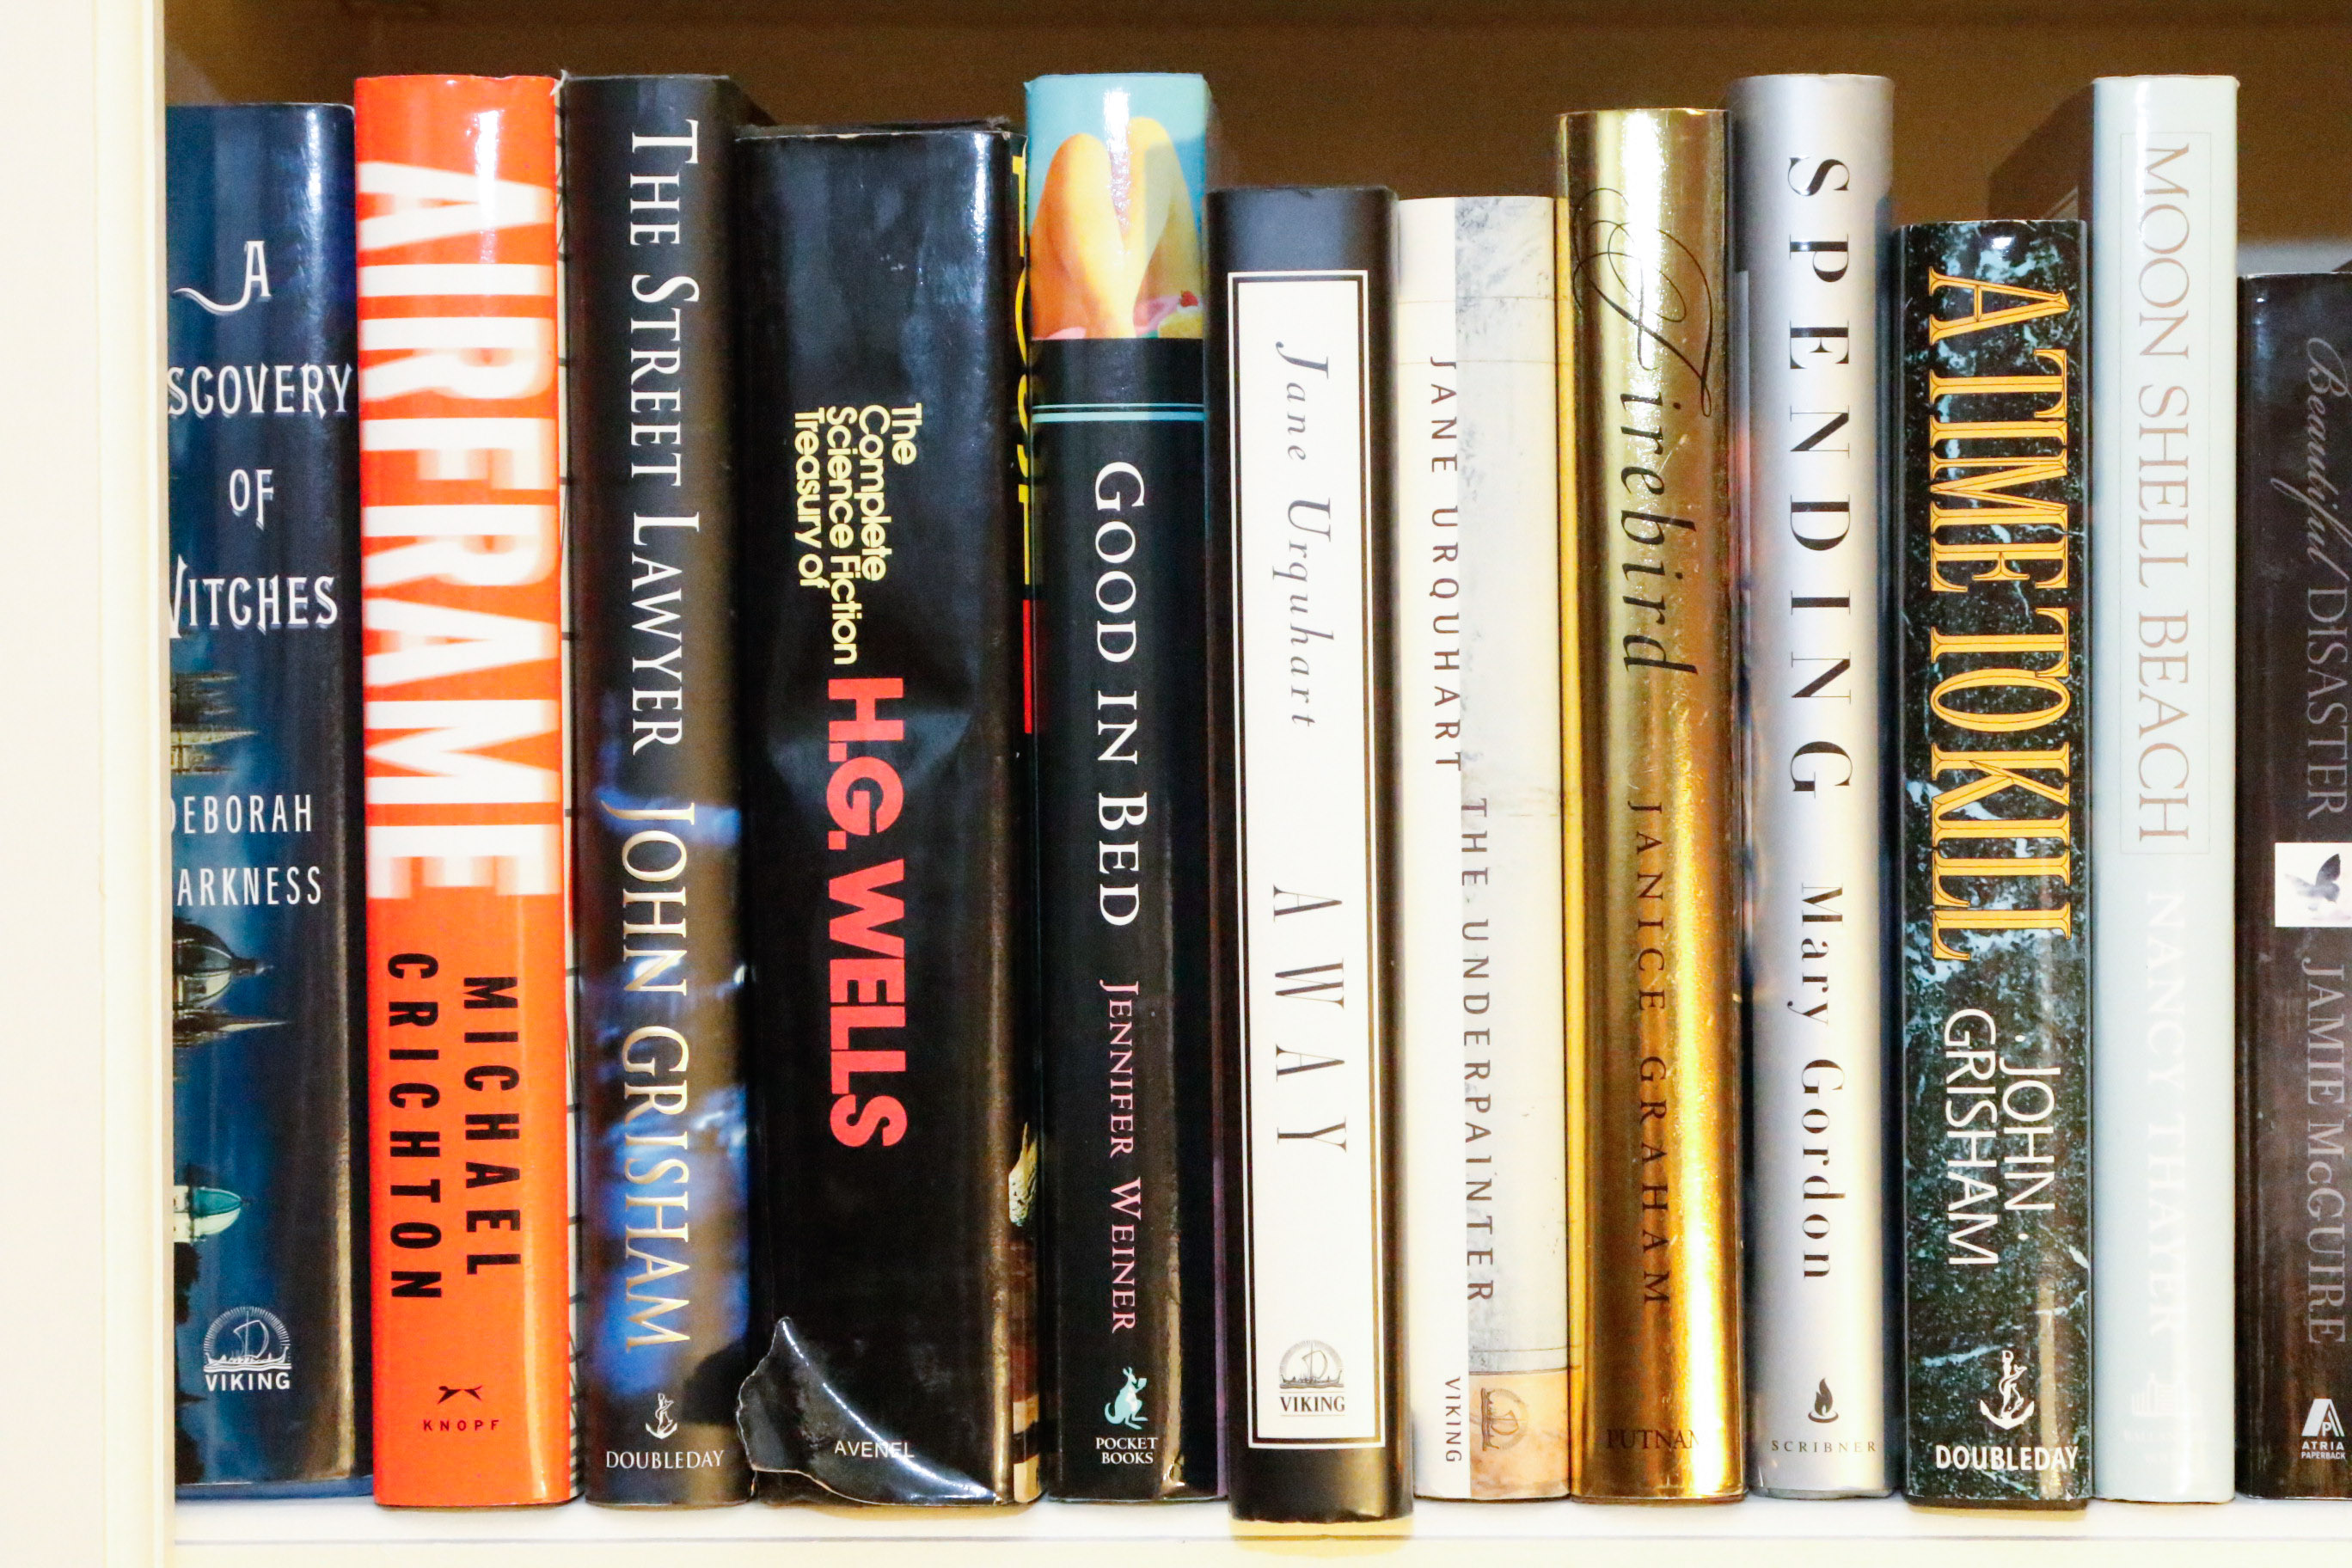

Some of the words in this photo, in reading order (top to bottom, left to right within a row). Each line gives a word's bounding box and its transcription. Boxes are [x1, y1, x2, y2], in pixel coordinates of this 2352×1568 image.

[629, 119, 700, 246] THE
[2138, 143, 2190, 360] MOON
[174, 240, 272, 315] A
[1927, 266, 2071, 345] A
[629, 274, 700, 487] STREET
[891, 402, 922, 465] The
[1276, 341, 1330, 460] Jane
[1430, 357, 1459, 473] JANE
[1573, 187, 1712, 676] Firebird
[2270, 336, 2352, 580] Beautiful
[229, 468, 275, 530] OF
[358, 161, 560, 899] AIRFRAME
[794, 407, 825, 548] Treasury
[826, 406, 857, 548] Science
[854, 404, 892, 582] Complete
[1787, 156, 1854, 799] SPENDING
[1929, 348, 2069, 593] TIME
[2138, 386, 2190, 588] SHELL
[631, 511, 700, 753] LAWYER
[799, 552, 830, 588] of
[830, 555, 861, 665] Fiction
[1094, 462, 1145, 662] GOOD
[1273, 497, 1334, 726] Urquhart
[1429, 506, 1462, 771] URQUHART
[1097, 690, 1138, 764] IN
[1929, 608, 2071, 733] TO
[2138, 612, 2190, 843] BEACH
[2307, 587, 2349, 820] DISASTER
[827, 677, 904, 850] H.G.
[1461, 798, 1488, 886] THE
[177, 867, 322, 906] ARKNESS
[601, 800, 695, 994] JOHN
[1098, 792, 1148, 926] BED
[1628, 800, 1664, 1010] JANICE
[1931, 743, 2072, 960] KILL
[829, 860, 908, 1147] WELLS
[1272, 885, 1348, 1153] AWAY
[1787, 883, 1844, 1025] Mary
[2147, 891, 2186, 1091] NANCY
[2302, 957, 2346, 1106] JAMIE
[389, 952, 442, 1299] CRICHTON
[462, 976, 521, 1274] MICHAEL
[1099, 980, 1139, 1158] JENNIFER
[1462, 918, 1494, 1302] UNDERPAINTER
[1944, 1008, 1999, 1265] GRISHAM
[1999, 1057, 2061, 1210] JOHN
[622, 1026, 691, 1349] GRISHAM
[1639, 1057, 1670, 1305] GRAHAM
[1801, 1060, 1847, 1279] Gordon
[2147, 1112, 2188, 1338] THAYER
[2305, 1119, 2347, 1343] McGUIRE
[1111, 1176, 1142, 1333] WEINER
[205, 1371, 291, 1392] VIKING
[422, 1418, 500, 1431] KNOPF
[606, 1449, 724, 1469] DOUBLEDAY
[835, 1440, 915, 1460] AVENEL
[1096, 1436, 1158, 1449] POCKET
[1101, 1451, 1154, 1464] BOOKS
[1280, 1396, 1345, 1412] VIKING
[1444, 1376, 1461, 1462] VIKING
[1772, 1439, 1877, 1454] SCRIBNER
[1935, 1445, 2079, 1471] DOUBLEDAY
[2300, 1451, 2346, 1460] PAPERBACK
[2301, 1441, 2345, 1451] ATRIA
